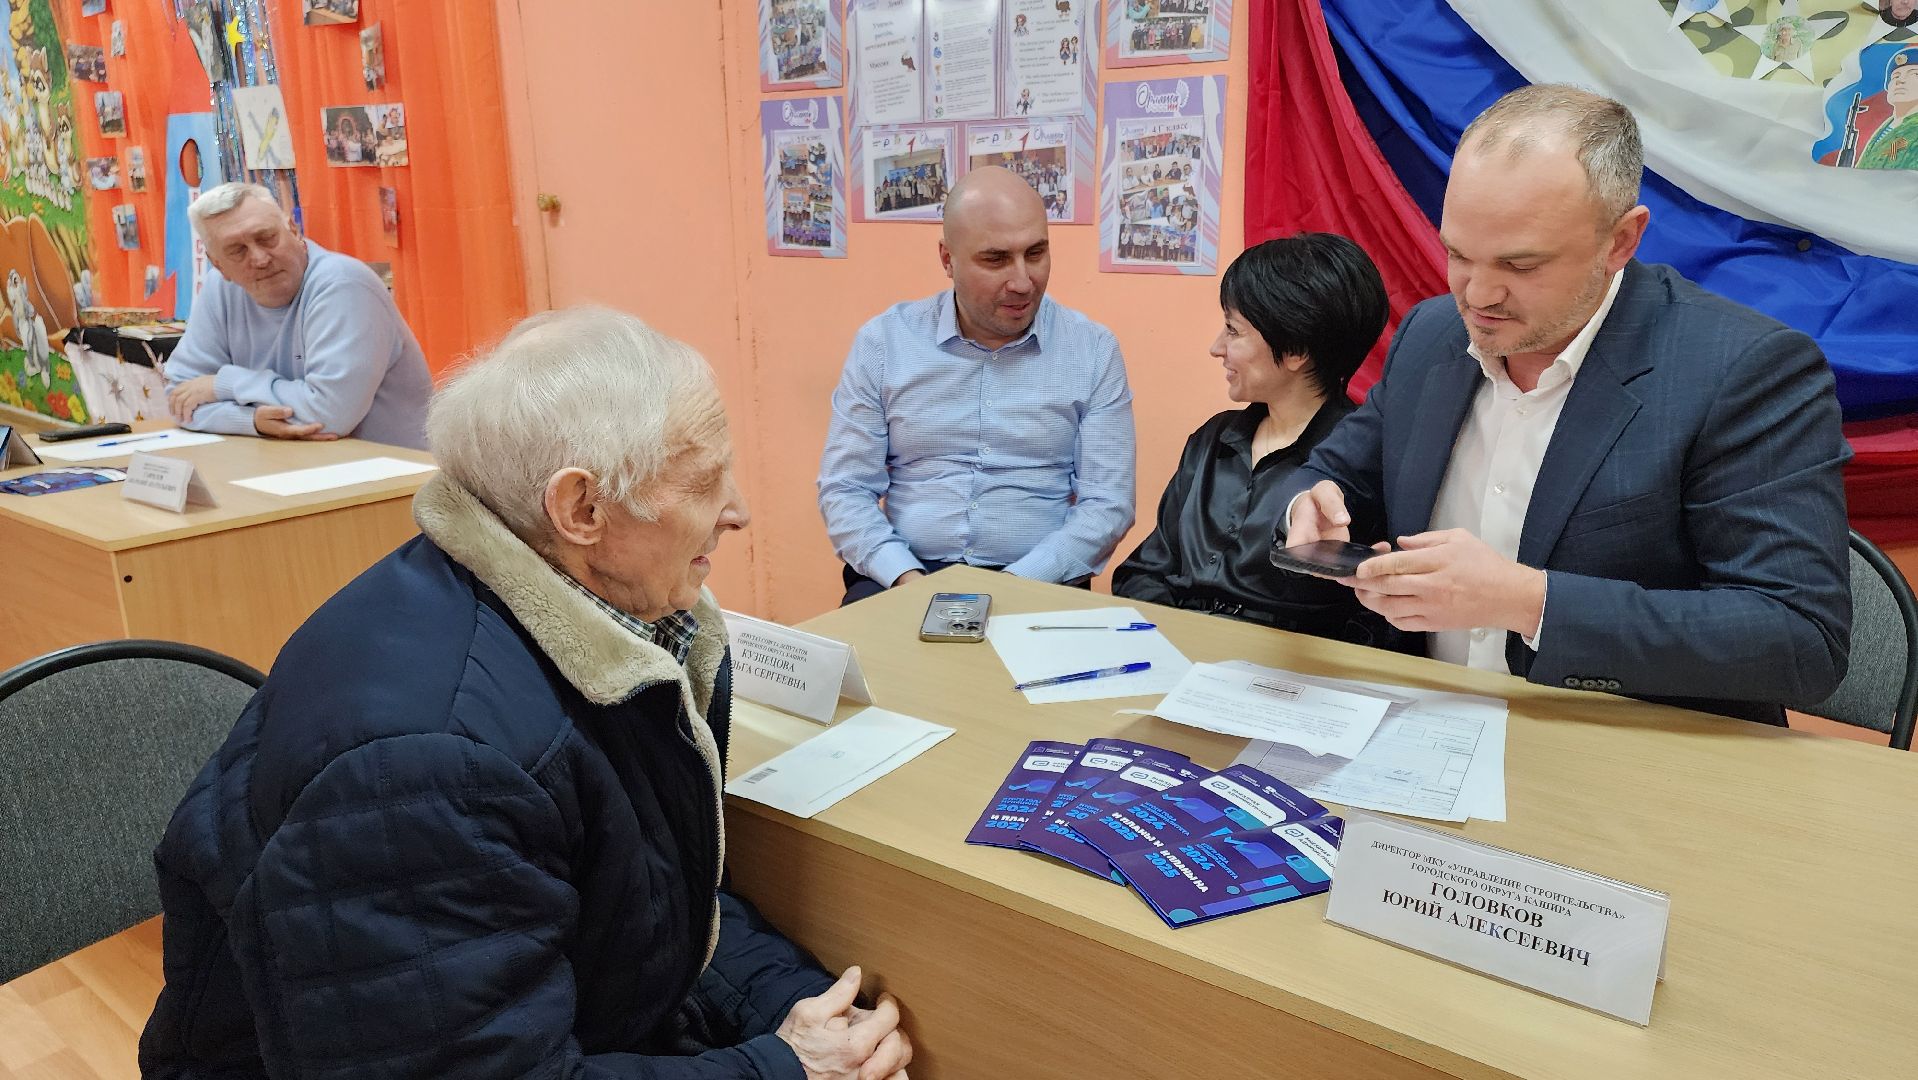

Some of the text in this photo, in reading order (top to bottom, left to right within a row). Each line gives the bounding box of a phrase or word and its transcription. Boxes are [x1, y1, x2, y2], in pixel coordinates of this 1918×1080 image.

[741, 648, 795, 672] КУЗНЕЦОВА
[754, 667, 807, 691] СЕРГЕЕВНА
[996, 804, 1037, 813] 202
[1127, 806, 1167, 830] 2024
[1099, 816, 1139, 841] 2025
[1119, 816, 1157, 841] ПЛАНЫ
[1144, 852, 1181, 878] 2025
[1179, 844, 1216, 871] 2024
[1166, 855, 1198, 881] ПЛАНЫ
[1192, 879, 1209, 893] НА
[1370, 840, 1626, 920] ДИРЕКТОР МКУ «УПРАВЛЕНИЕ СТРОИТЕЛЬСТВА»
[1410, 862, 1572, 917] ГОРОДСКОГО ОКРУГА КАШИРА
[1430, 881, 1544, 928] ГОЛОВКОВ
[1382, 888, 1592, 968] ЮРИЙ АЛЕКСЕЕВИЧ
